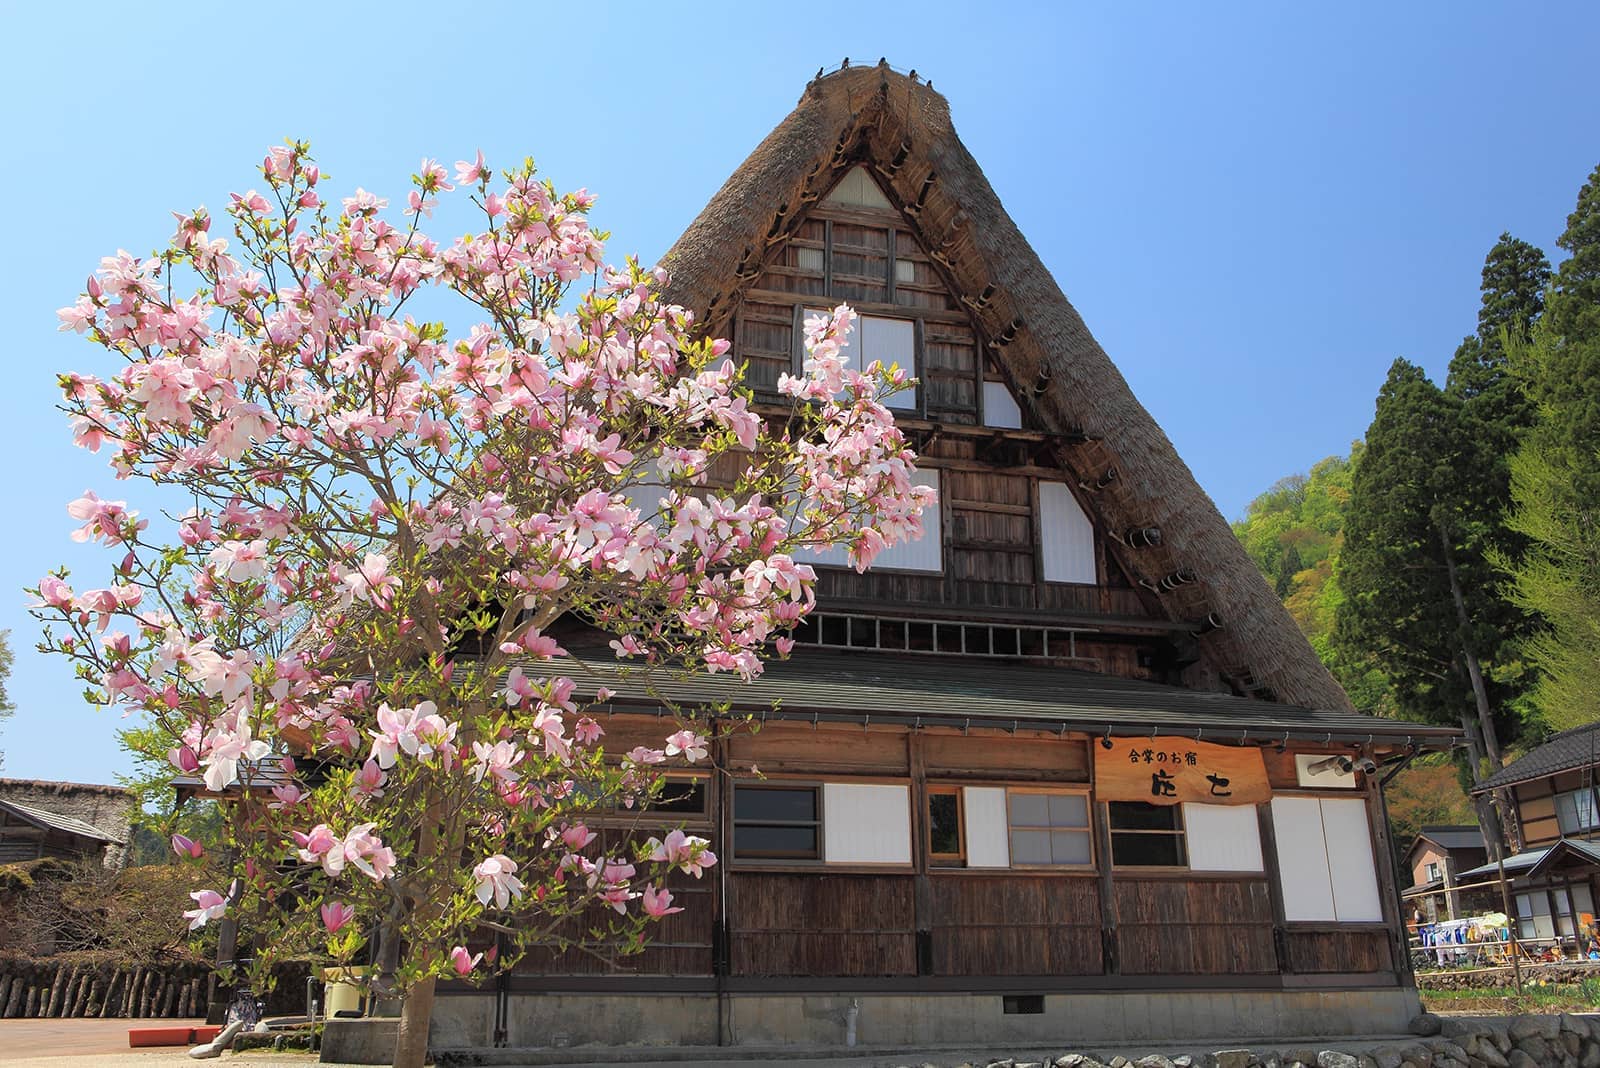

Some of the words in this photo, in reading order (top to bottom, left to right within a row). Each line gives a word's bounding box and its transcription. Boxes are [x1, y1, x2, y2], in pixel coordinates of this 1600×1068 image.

[1128, 748, 1198, 766] 合掌のお宿
